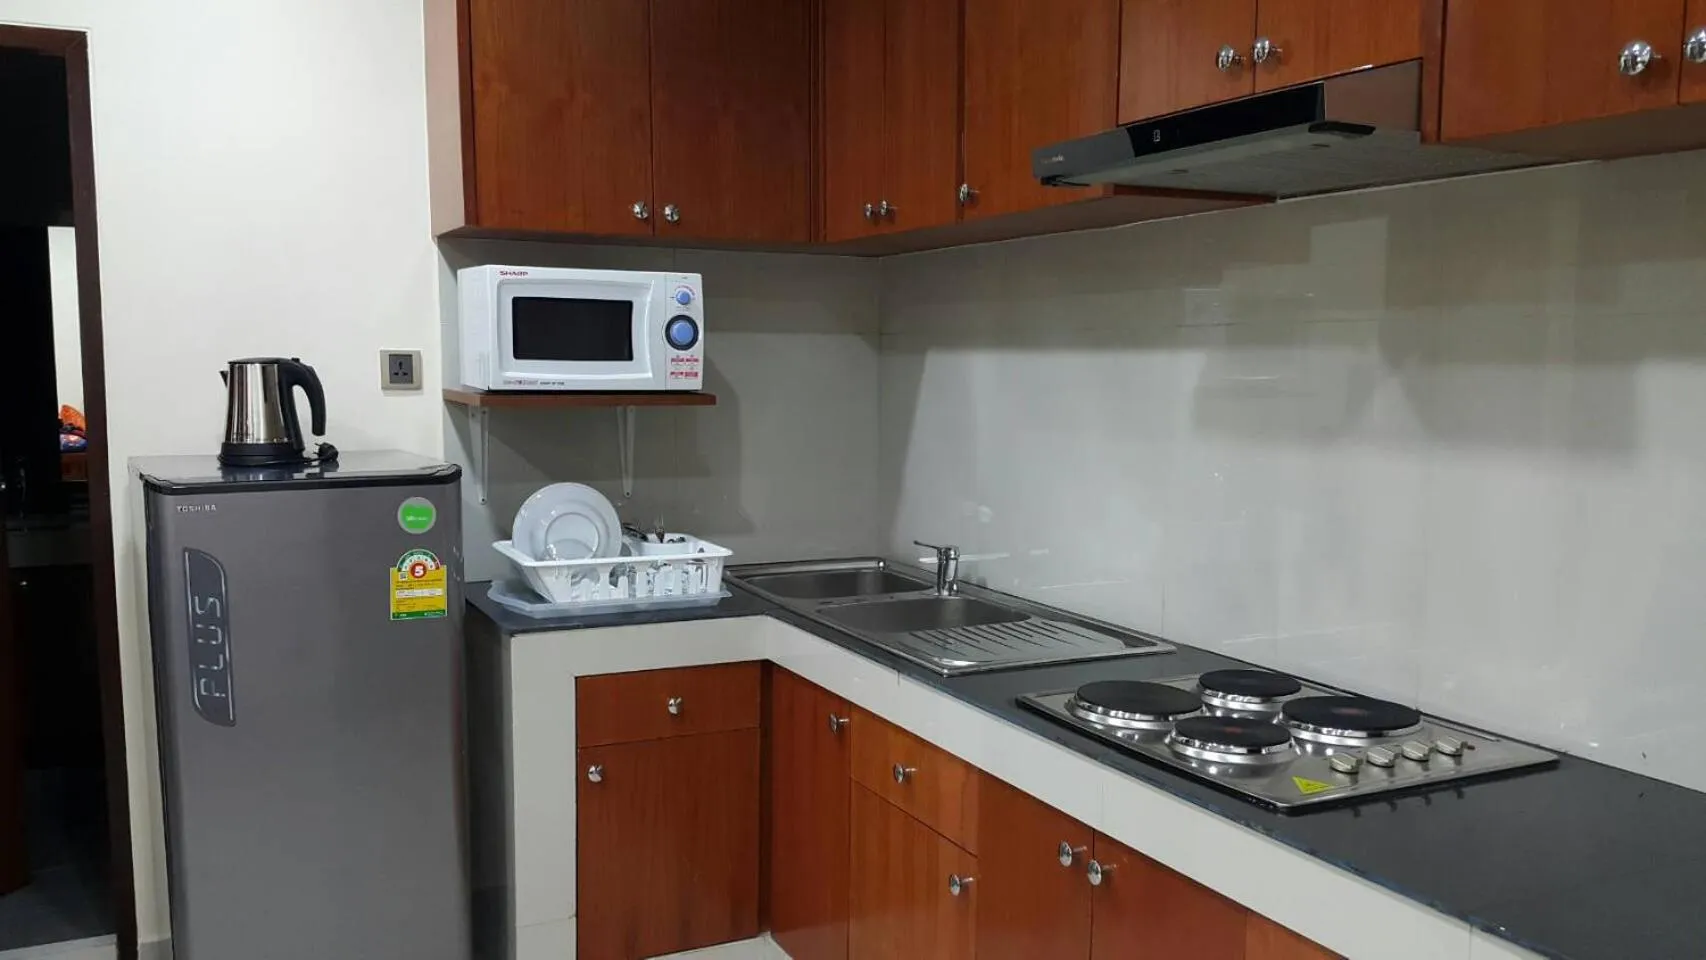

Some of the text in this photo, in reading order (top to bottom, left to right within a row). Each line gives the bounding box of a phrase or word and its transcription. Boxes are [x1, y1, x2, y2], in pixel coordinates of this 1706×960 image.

[176, 504, 217, 512] TOSHIBA
[414, 565, 424, 577] 5
[193, 595, 226, 697] PLUS
